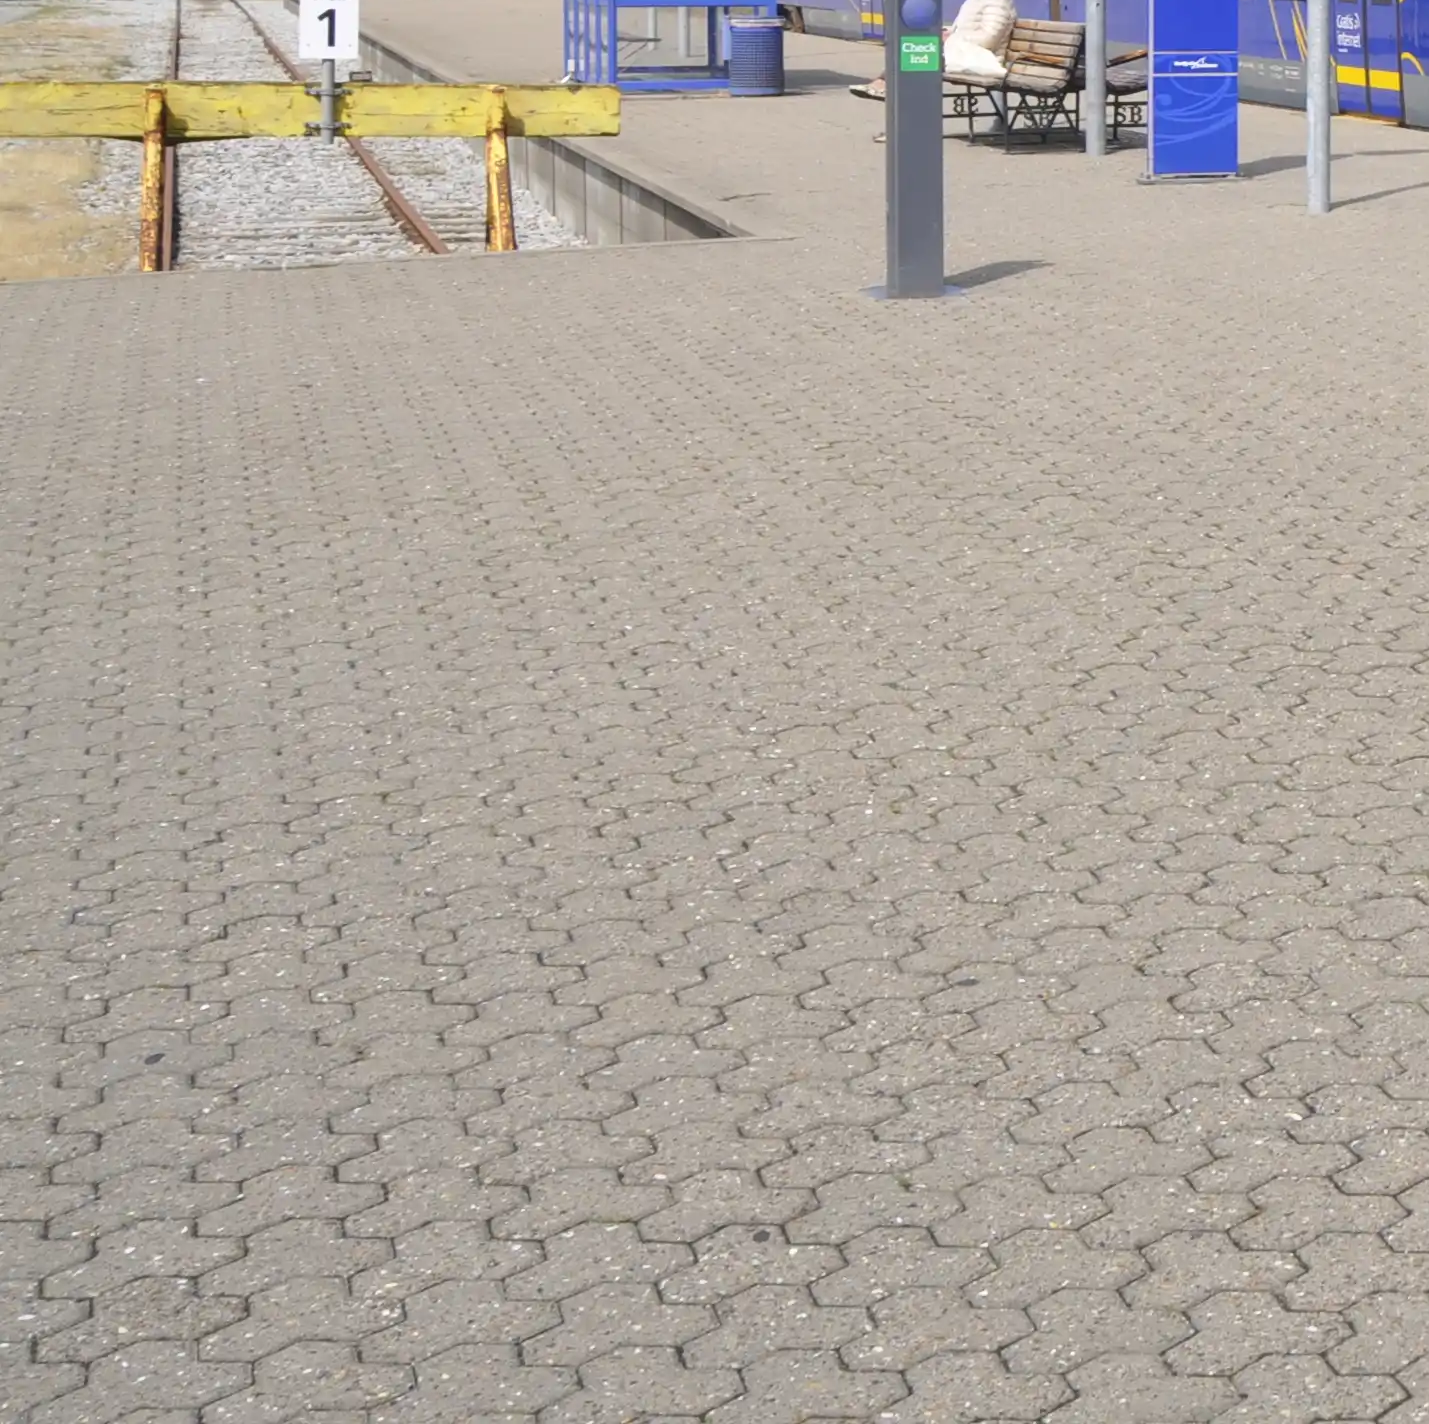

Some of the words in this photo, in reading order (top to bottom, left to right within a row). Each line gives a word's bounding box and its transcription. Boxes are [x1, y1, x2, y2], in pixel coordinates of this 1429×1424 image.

[317, 8, 336, 47] 1
[902, 42, 937, 53] Check
[910, 54, 929, 64] ind
[1116, 105, 1144, 124] SB
